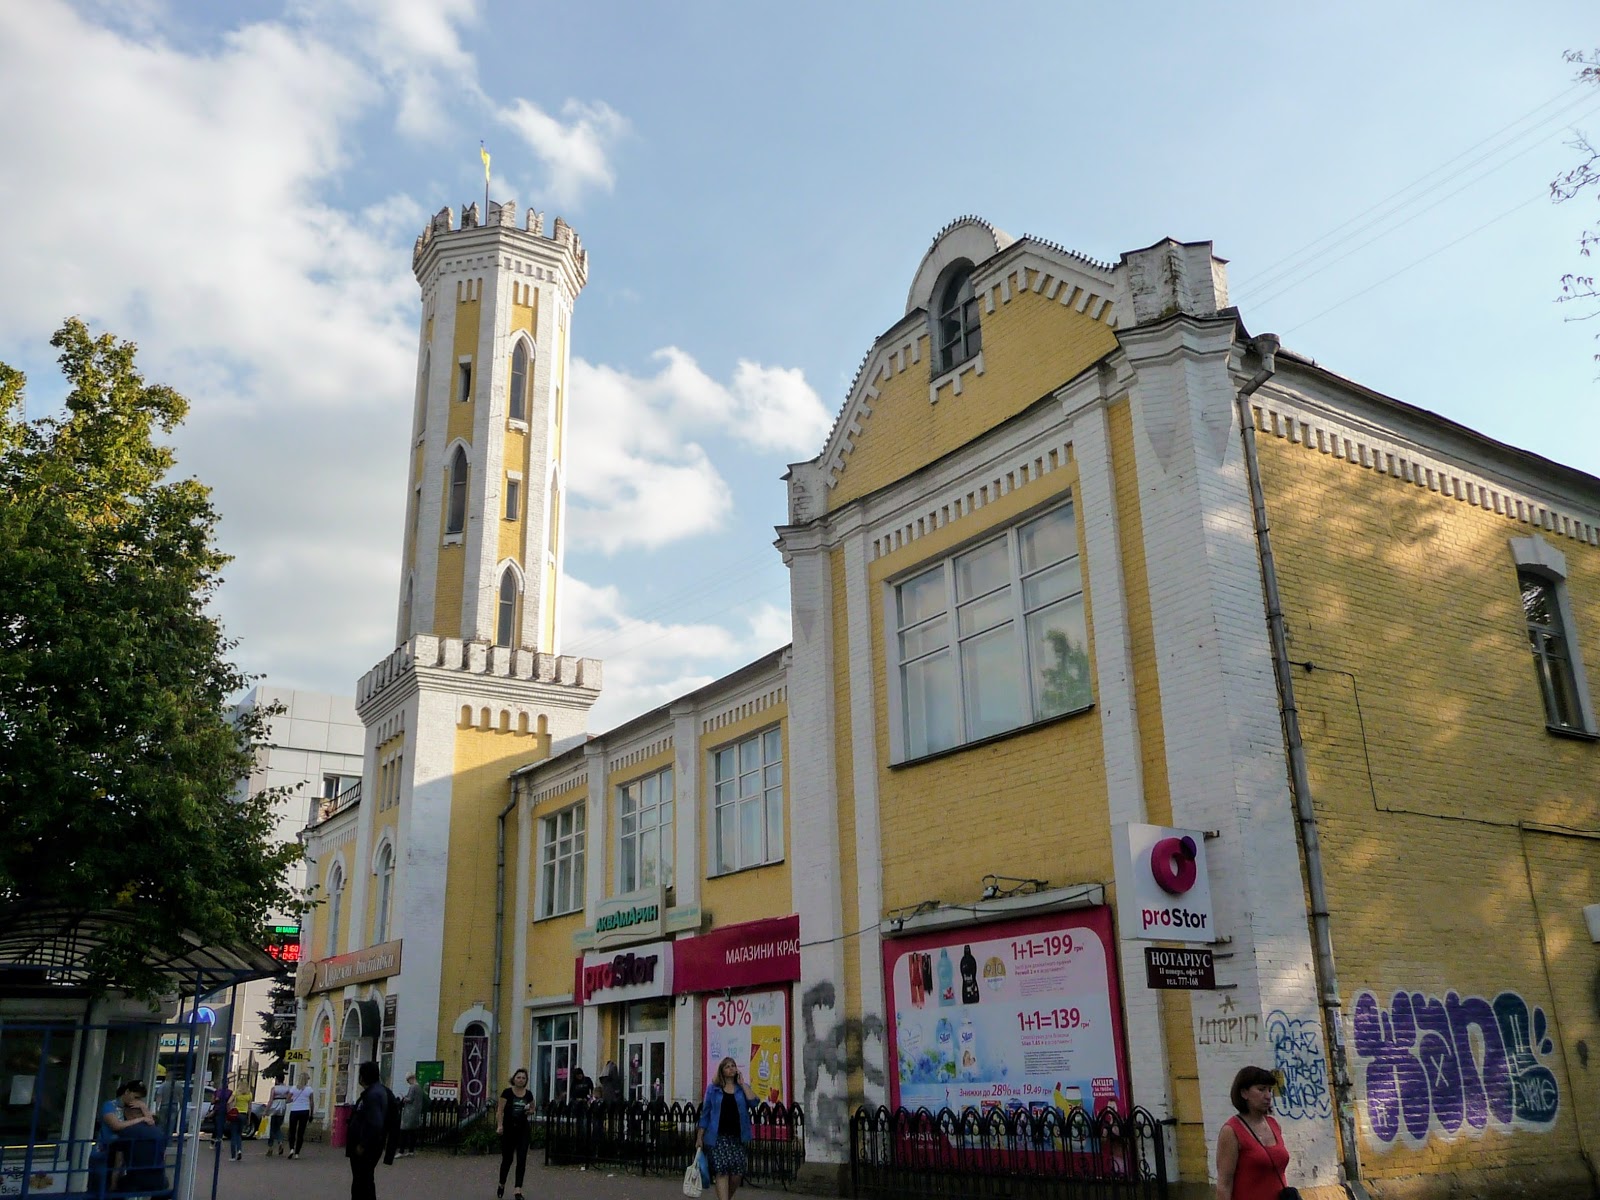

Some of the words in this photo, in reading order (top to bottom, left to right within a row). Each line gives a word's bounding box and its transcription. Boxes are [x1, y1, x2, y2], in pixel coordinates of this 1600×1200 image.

[595, 905, 659, 933] АКВАМАРИН
[1142, 908, 1207, 930] proStor
[725, 943, 775, 965] МАГАЗИНИ
[1011, 934, 1073, 960] 1+1=199
[1151, 951, 1211, 968] НОТАРІУС
[584, 953, 659, 1000] proStor
[1178, 976, 1199, 986] 777-168
[711, 999, 752, 1027] -30%
[1017, 1007, 1080, 1031] 1+1=139
[287, 1052, 303, 1060] 24h
[431, 1088, 456, 1096] ФОТО
[959, 1088, 982, 1097] Знижки
[982, 1089, 991, 1098] до
[991, 1084, 1012, 1097] 28%
[1022, 1084, 1042, 1095] 19.49
[1092, 1078, 1114, 1087] АКЦІЯ
